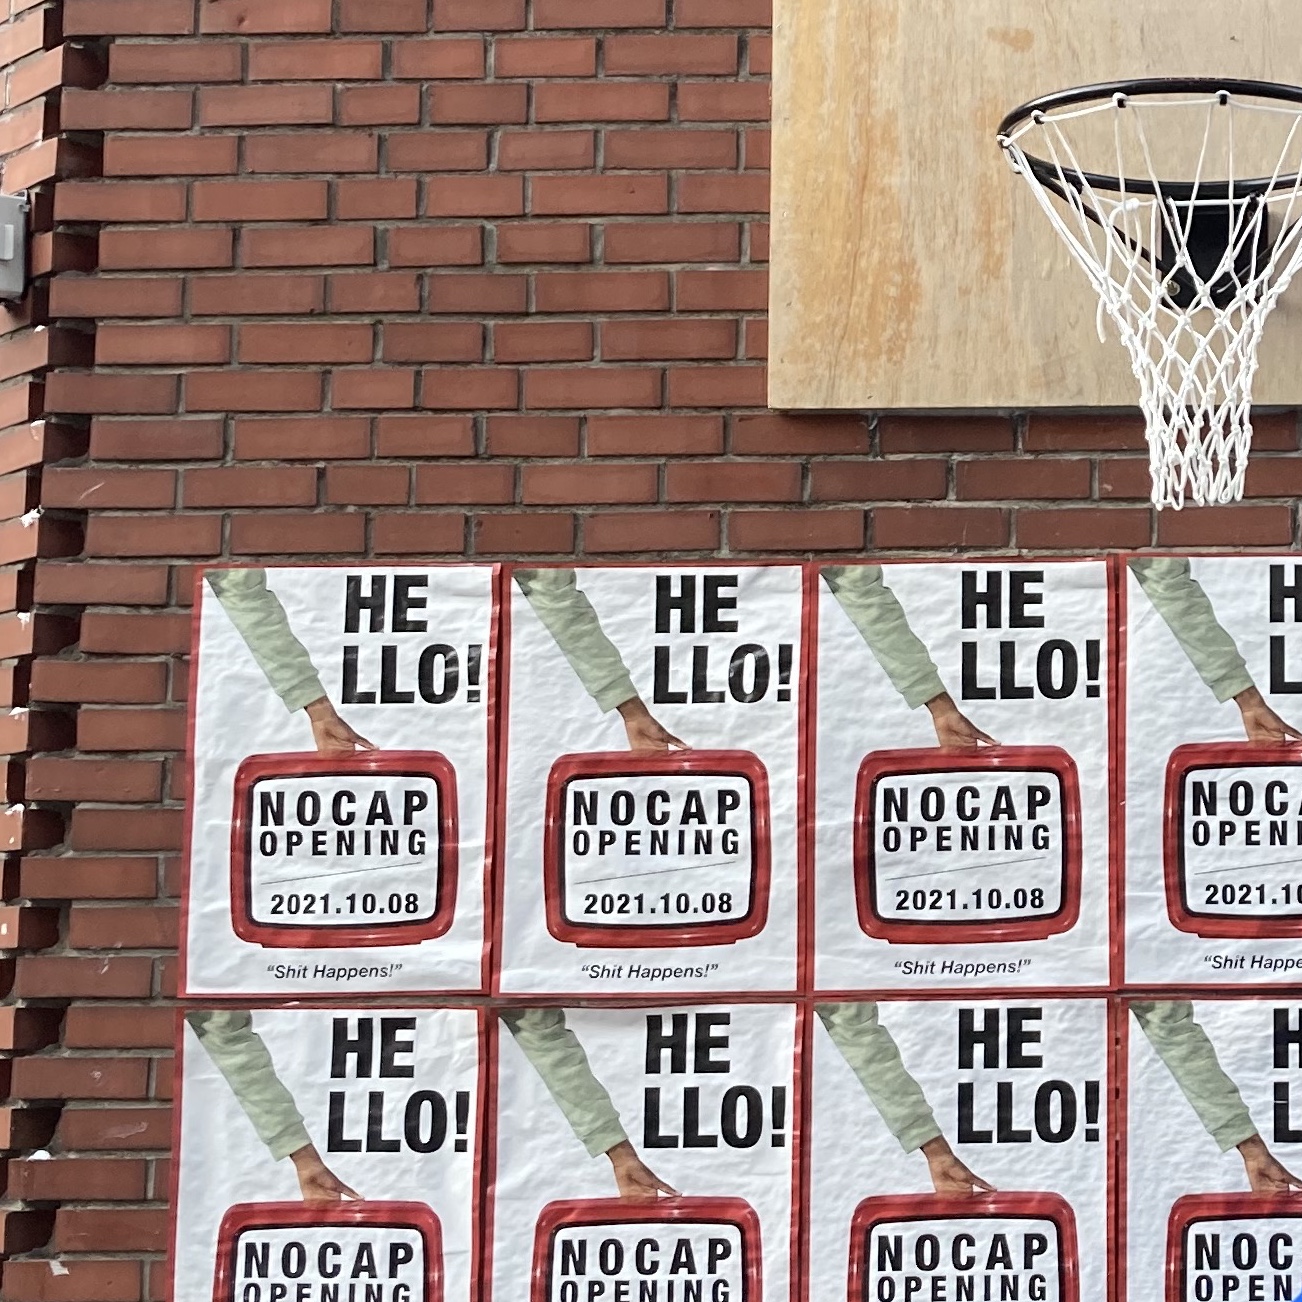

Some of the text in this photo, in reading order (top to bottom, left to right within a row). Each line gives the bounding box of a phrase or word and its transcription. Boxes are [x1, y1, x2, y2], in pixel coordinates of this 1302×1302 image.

[344, 575, 428, 633] HE
[655, 575, 738, 633] HE
[962, 571, 1044, 629] HE
[342, 644, 482, 704] LLO!
[653, 644, 792, 704] LLO!
[962, 639, 1100, 700] LLO!
[260, 790, 427, 826] NOCAP
[574, 790, 740, 826] NOCAP
[883, 785, 1050, 822] NOCAP
[260, 830, 425, 856] OPENING
[573, 829, 738, 855] OPENING
[883, 825, 1049, 852] OPENING
[271, 893, 418, 914] 2021.10.08
[584, 893, 731, 914] 2021.10.08
[896, 888, 1043, 910] 2021.10.08
[330, 1017, 416, 1078] HE
[645, 1013, 730, 1074] HE
[958, 1008, 1042, 1069] HE
[327, 1090, 469, 1153] LLO!
[644, 1086, 786, 1148] LLO!
[958, 1080, 1099, 1144] LLO!
[244, 1242, 413, 1278] NOCAP
[561, 1238, 731, 1275] NOCAP
[878, 1234, 1047, 1271] NOCAP
[878, 1274, 1045, 1302] OPENING
